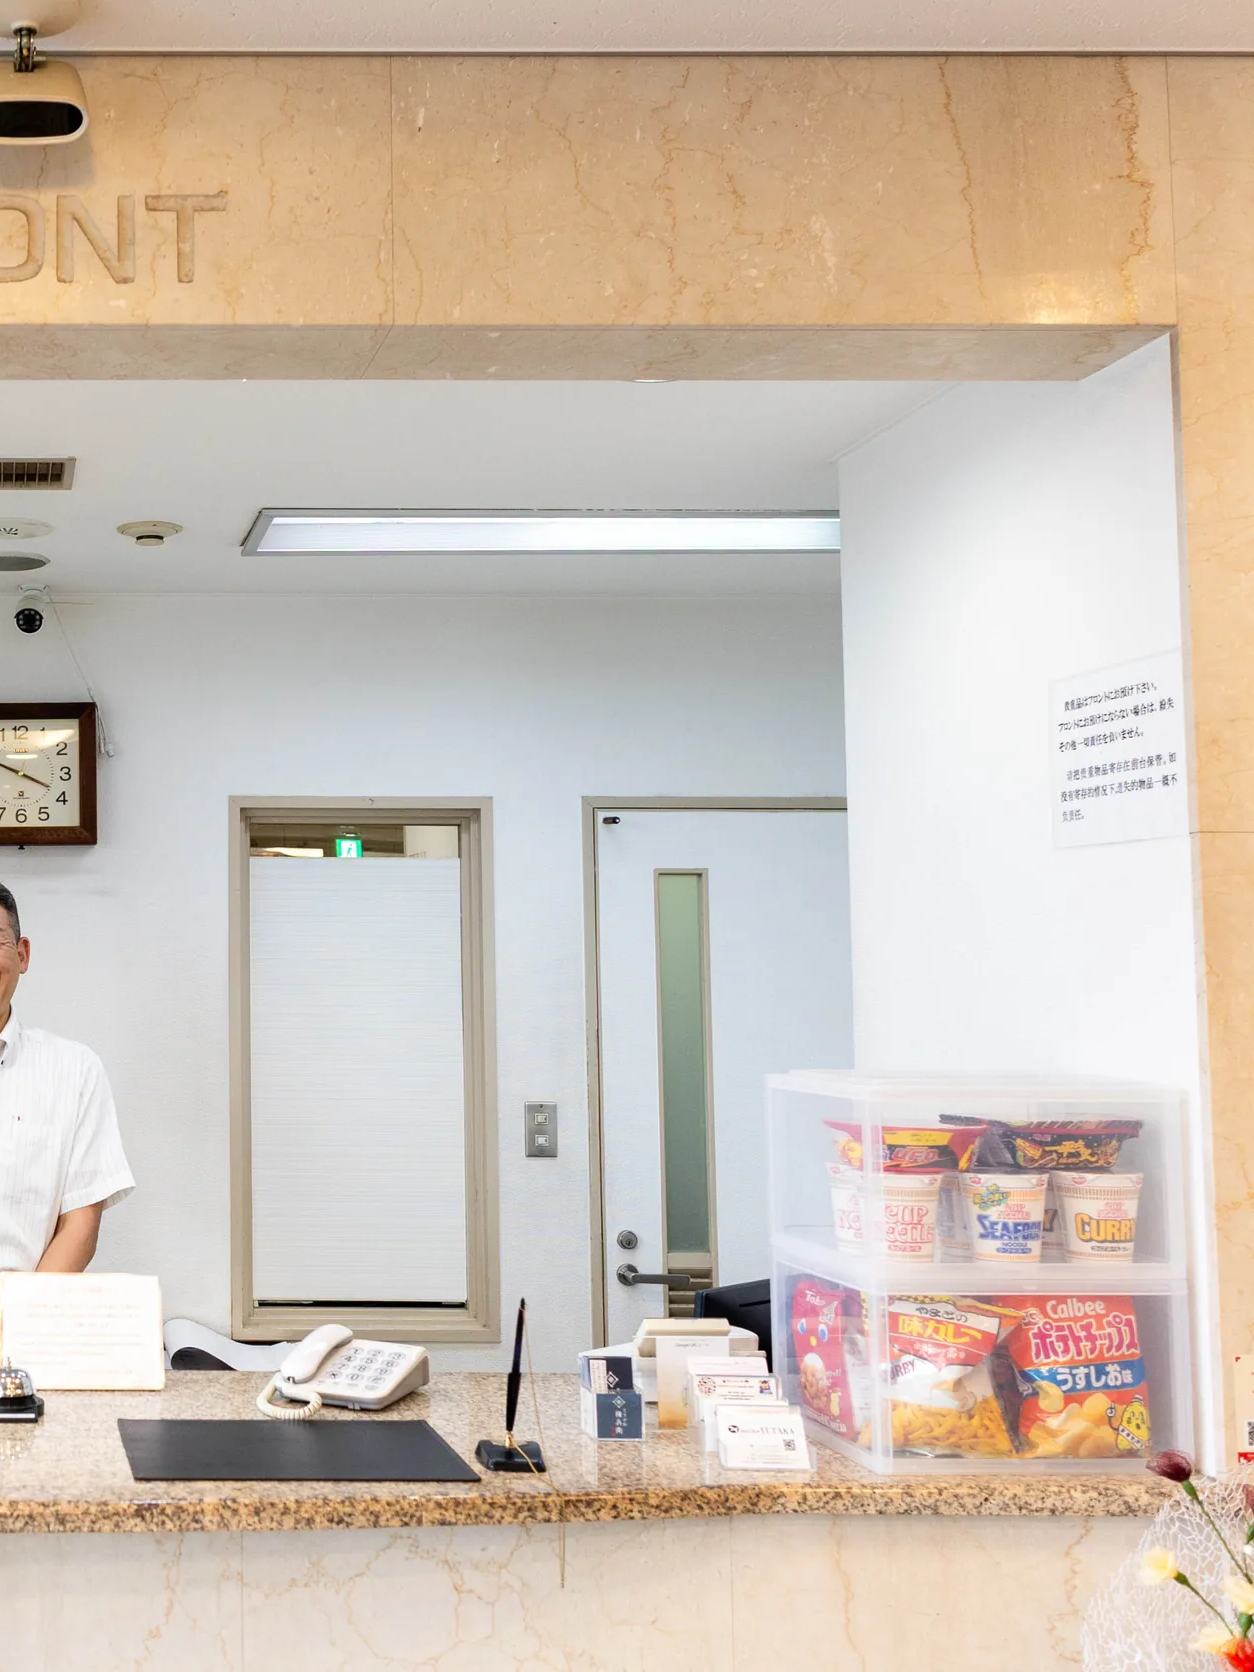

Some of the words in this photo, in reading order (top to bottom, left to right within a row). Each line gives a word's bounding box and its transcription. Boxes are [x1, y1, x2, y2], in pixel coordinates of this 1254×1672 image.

[12, 725, 29, 740] 12
[40, 727, 45, 739] 1
[56, 742, 68, 756] 2
[59, 767, 71, 781] 3
[56, 791, 68, 805] 4
[15, 808, 27, 823] 6
[38, 807, 50, 821] 5
[884, 1204, 929, 1225] CUP
[1046, 1298, 1106, 1318] Calbee
[898, 1315, 983, 1343] 味カレー
[1030, 1312, 1140, 1362] ポテトチップス
[1057, 1364, 1133, 1391] うすしお味
